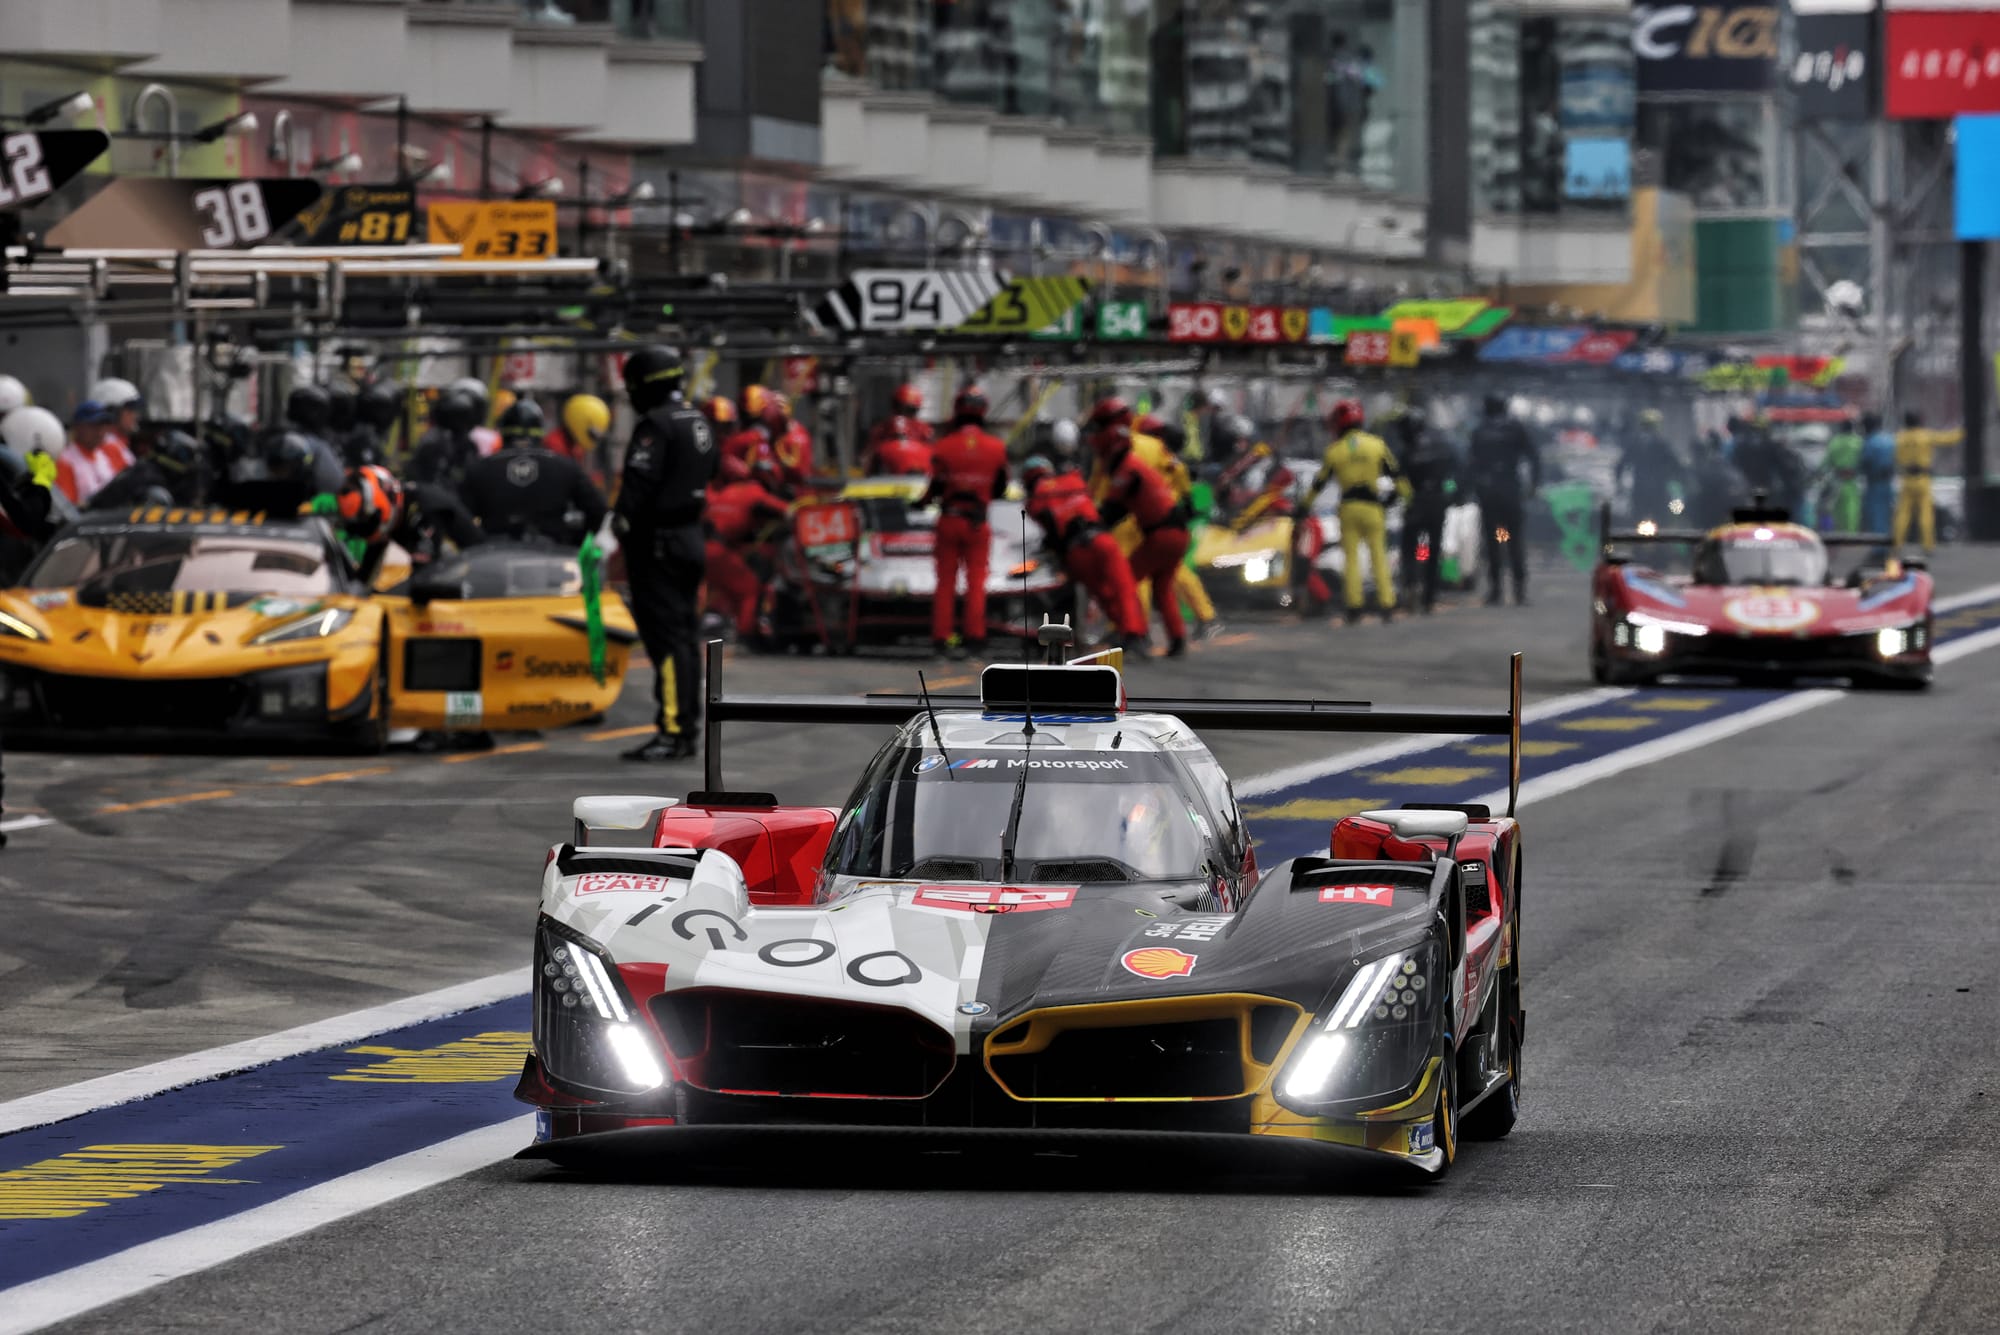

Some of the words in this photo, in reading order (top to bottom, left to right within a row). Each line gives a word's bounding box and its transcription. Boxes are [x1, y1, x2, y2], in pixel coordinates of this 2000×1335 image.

[195, 181, 269, 247] 38
[339, 211, 412, 241] #81
[475, 232, 548, 256] #33
[868, 279, 941, 323] 94
[1102, 304, 1143, 335] 54
[1170, 306, 1219, 337] 50
[807, 509, 846, 544] 54
[1007, 759, 1128, 771] Motorsport
[582, 880, 657, 892] CAR
[1324, 887, 1389, 900] HY
